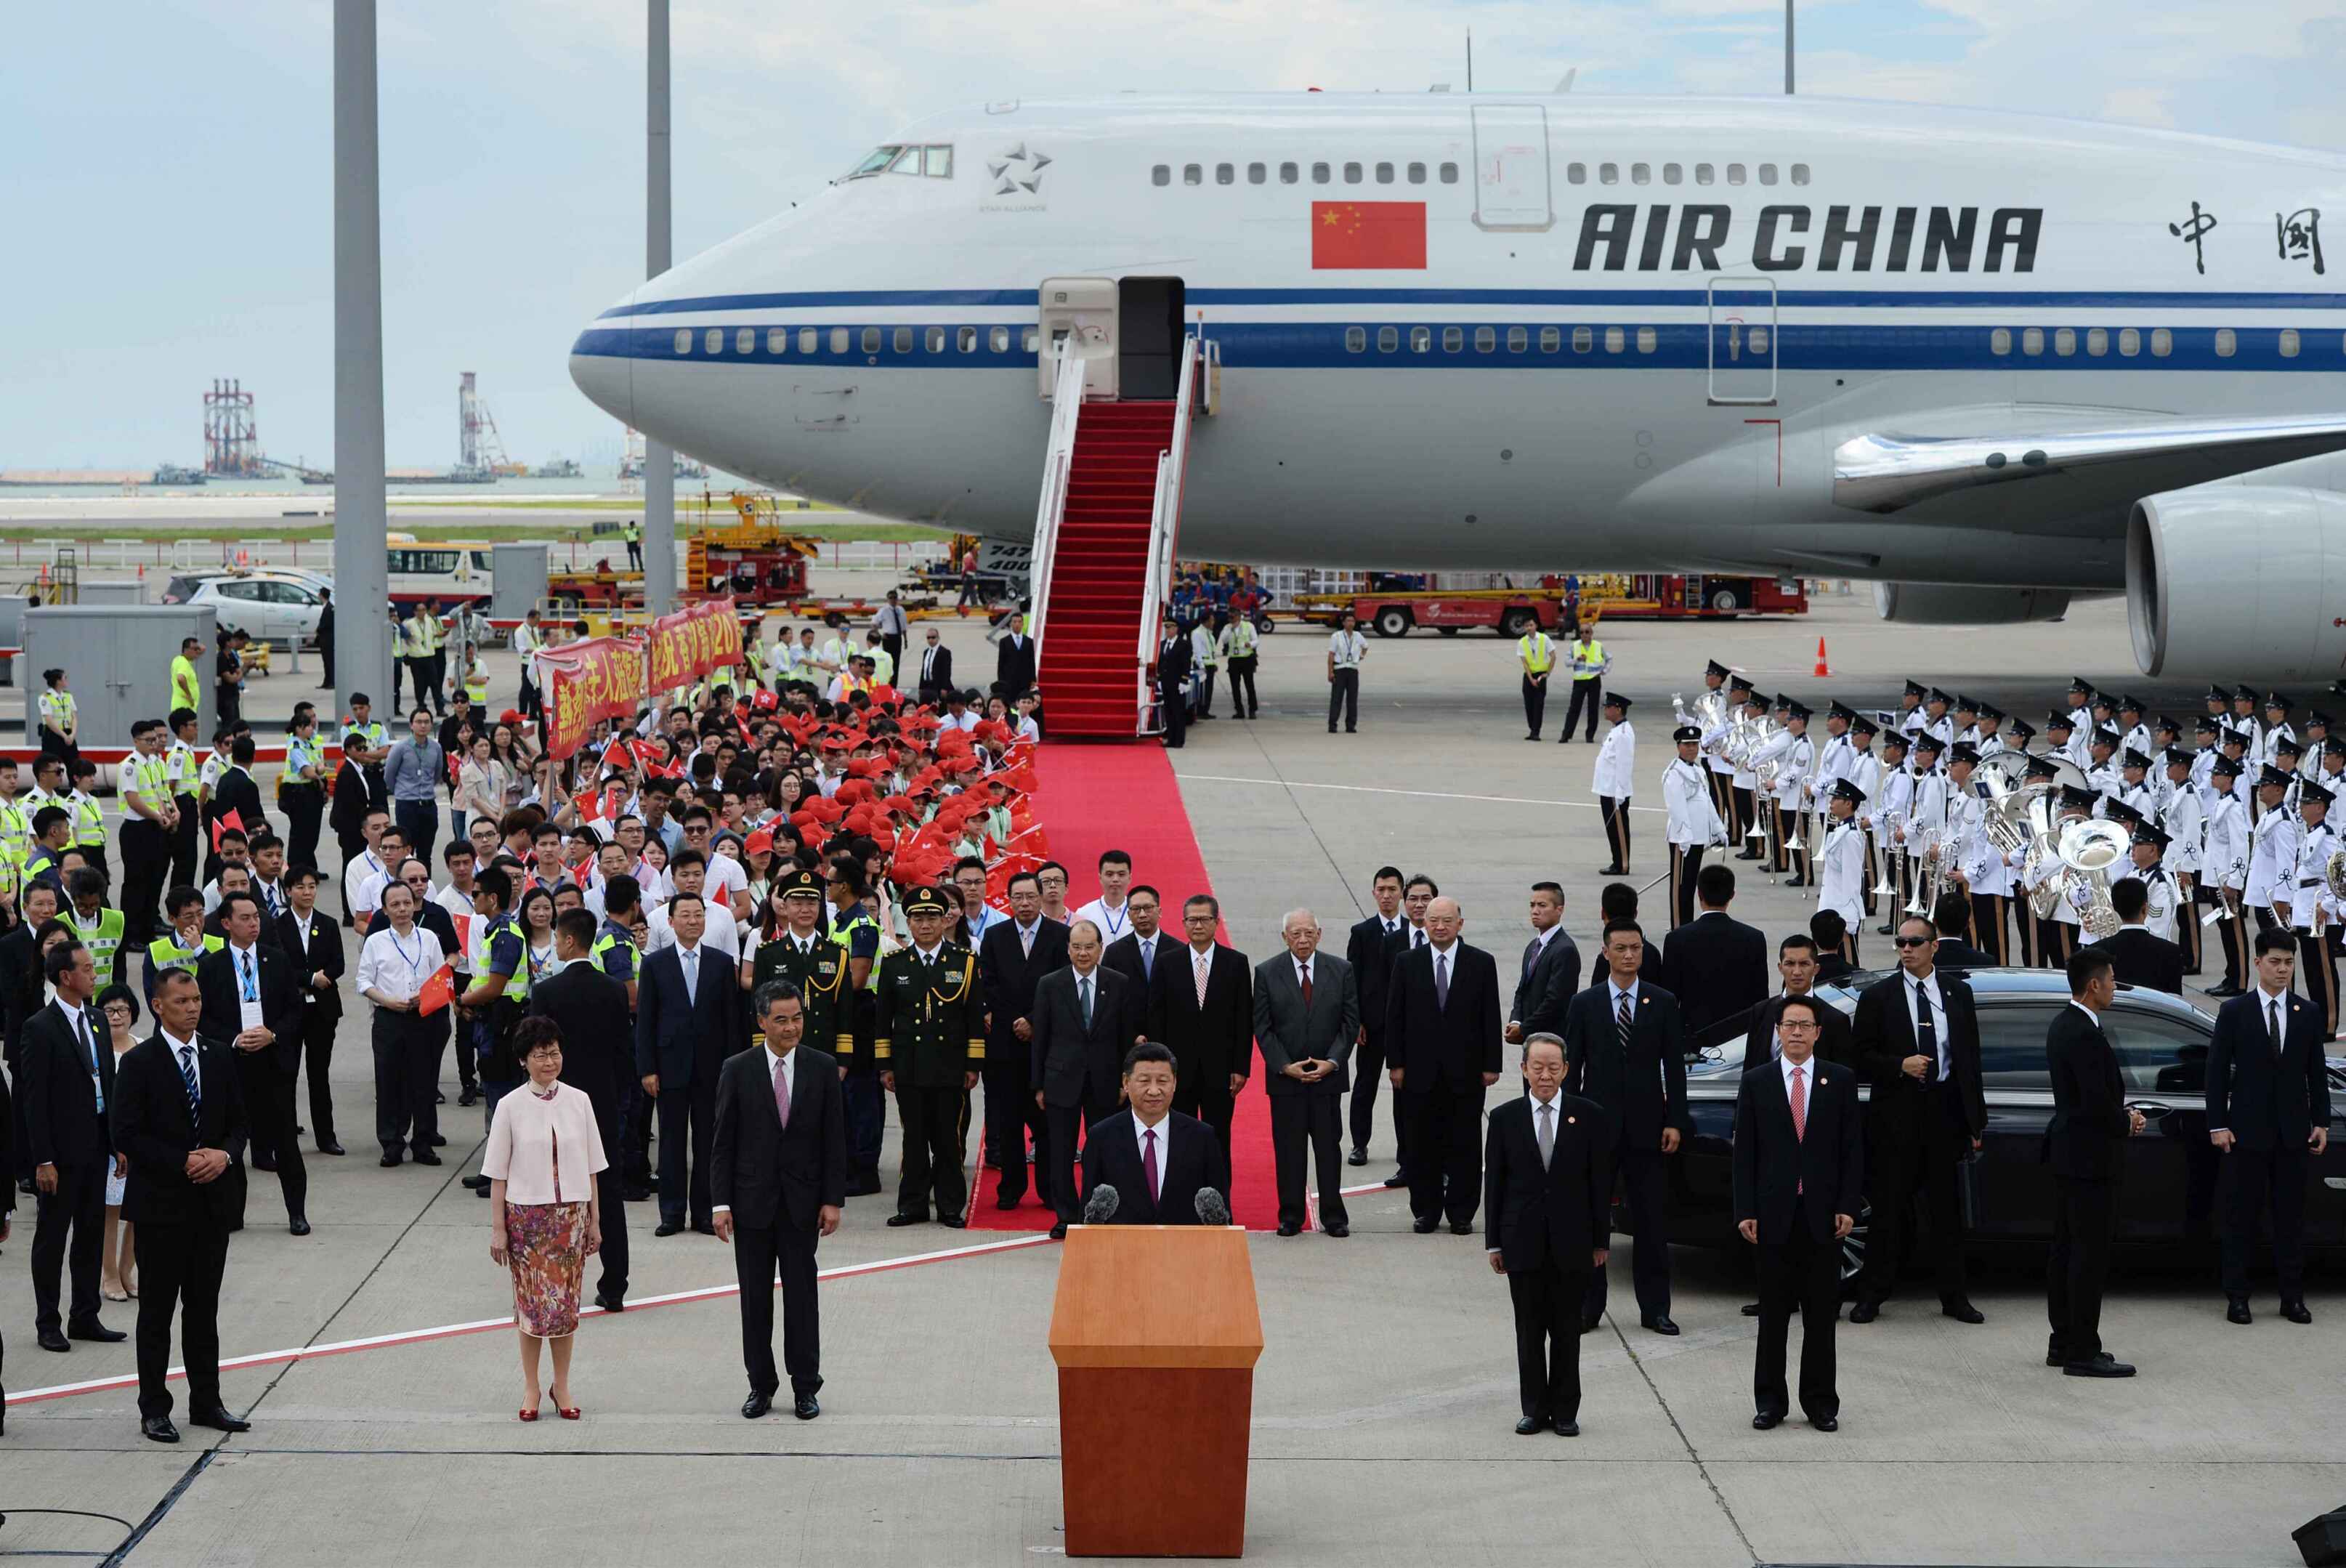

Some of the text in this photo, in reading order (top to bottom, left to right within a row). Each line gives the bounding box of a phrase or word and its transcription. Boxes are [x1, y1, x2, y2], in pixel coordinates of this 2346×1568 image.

[1573, 204, 2042, 272] AIR CHINA
[990, 545, 1032, 557] 747
[987, 560, 1032, 571] 400
